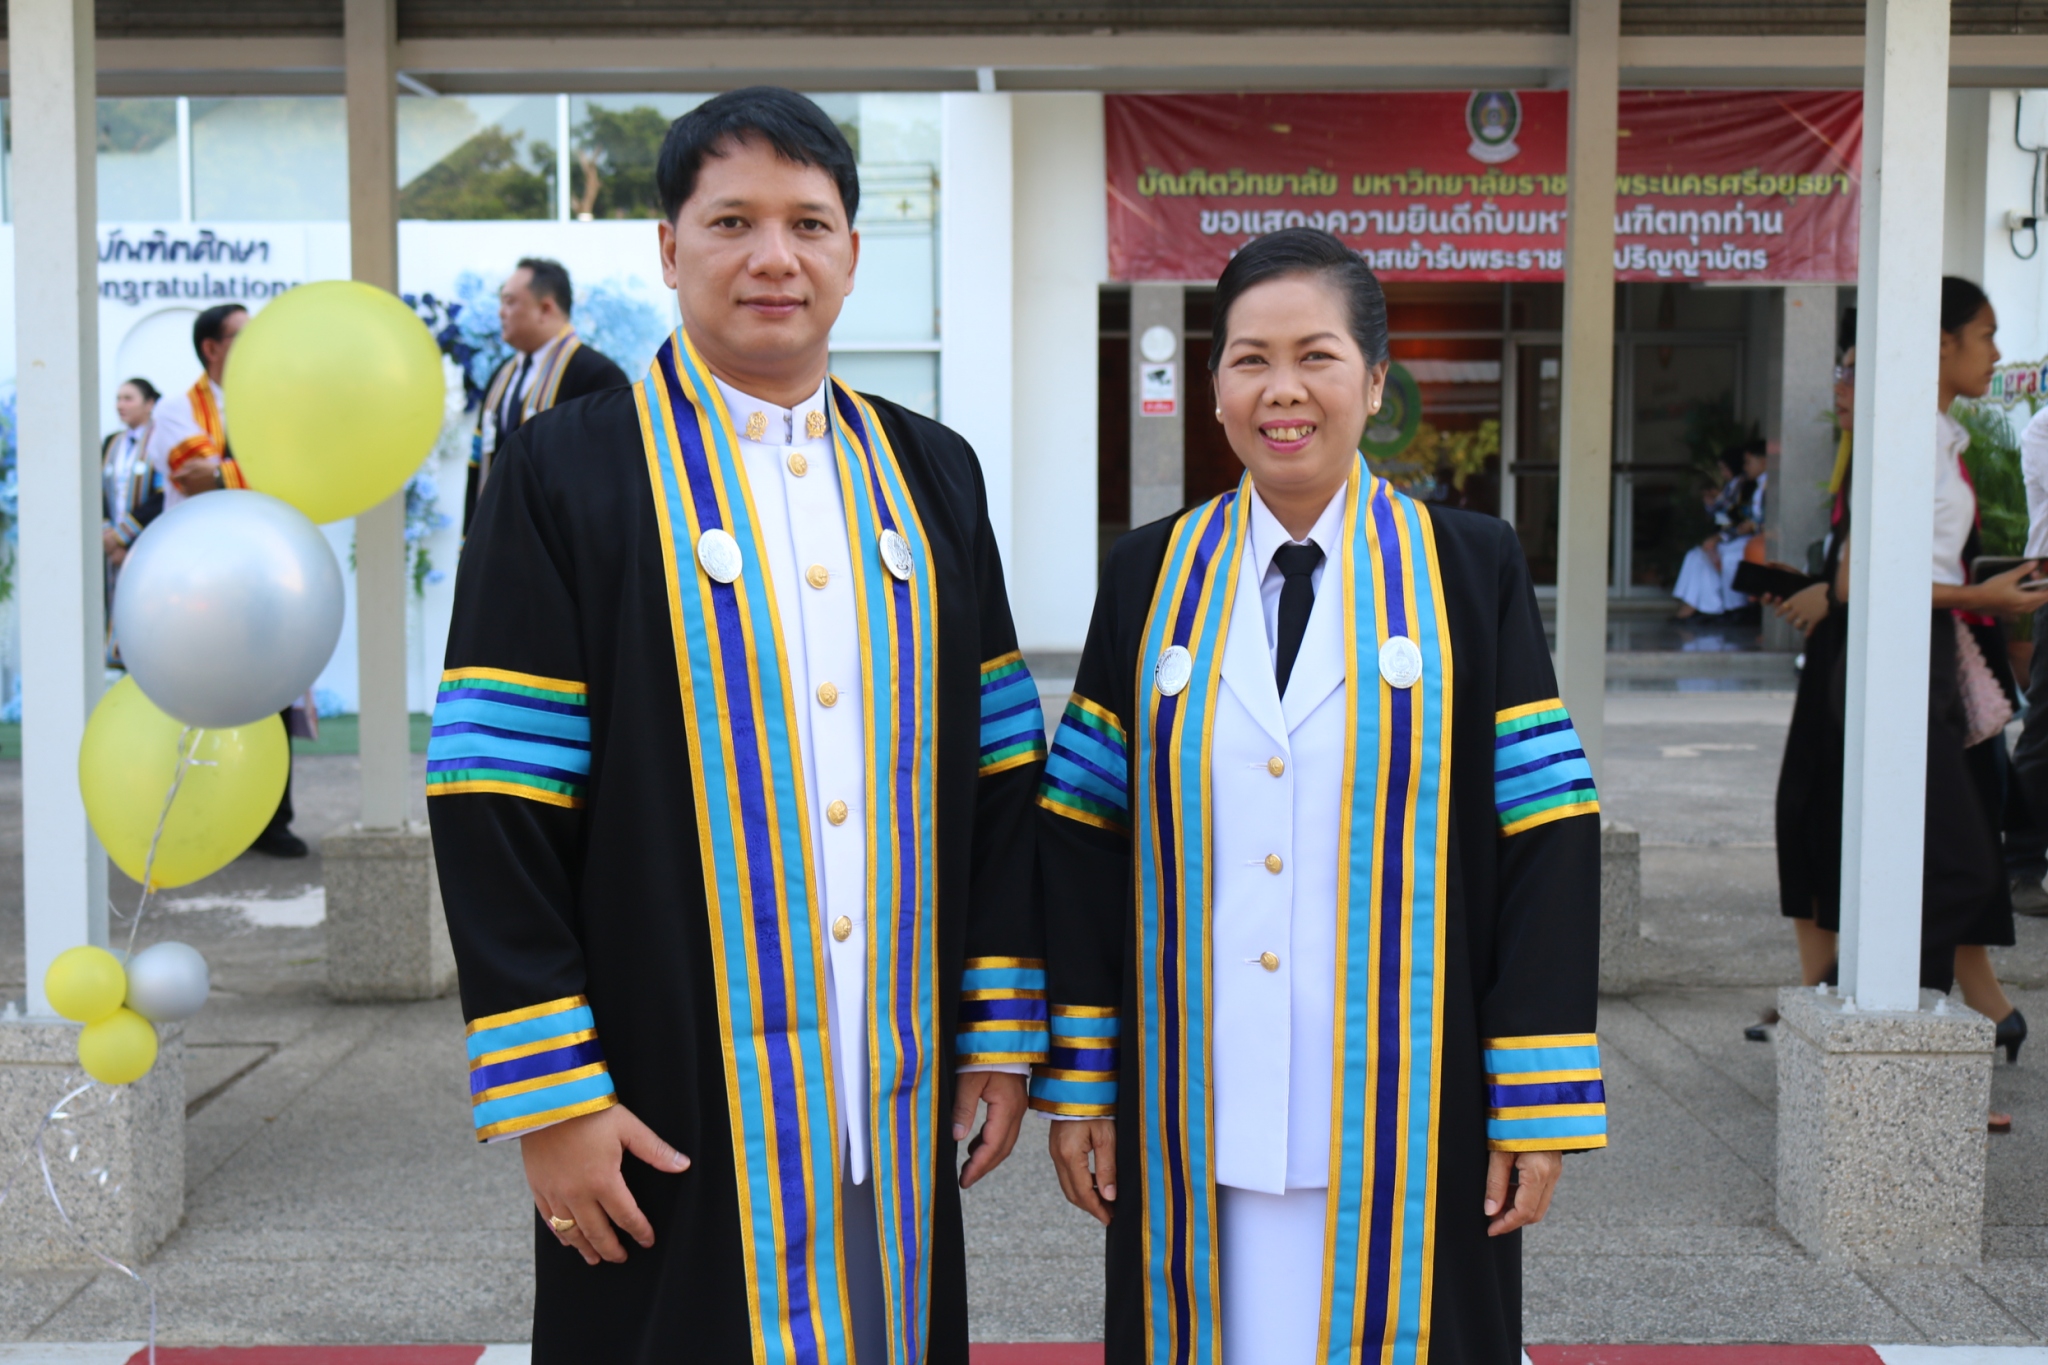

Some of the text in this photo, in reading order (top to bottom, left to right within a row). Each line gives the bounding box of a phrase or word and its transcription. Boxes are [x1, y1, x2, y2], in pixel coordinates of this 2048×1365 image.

[1137, 166, 1849, 204] บัณฑิตวิทยาลัย มหาวิทยาลัยราชพระนครศรีอยุธยา
[98, 273, 301, 307] ngratulation
[1984, 364, 2048, 405] ngrat
